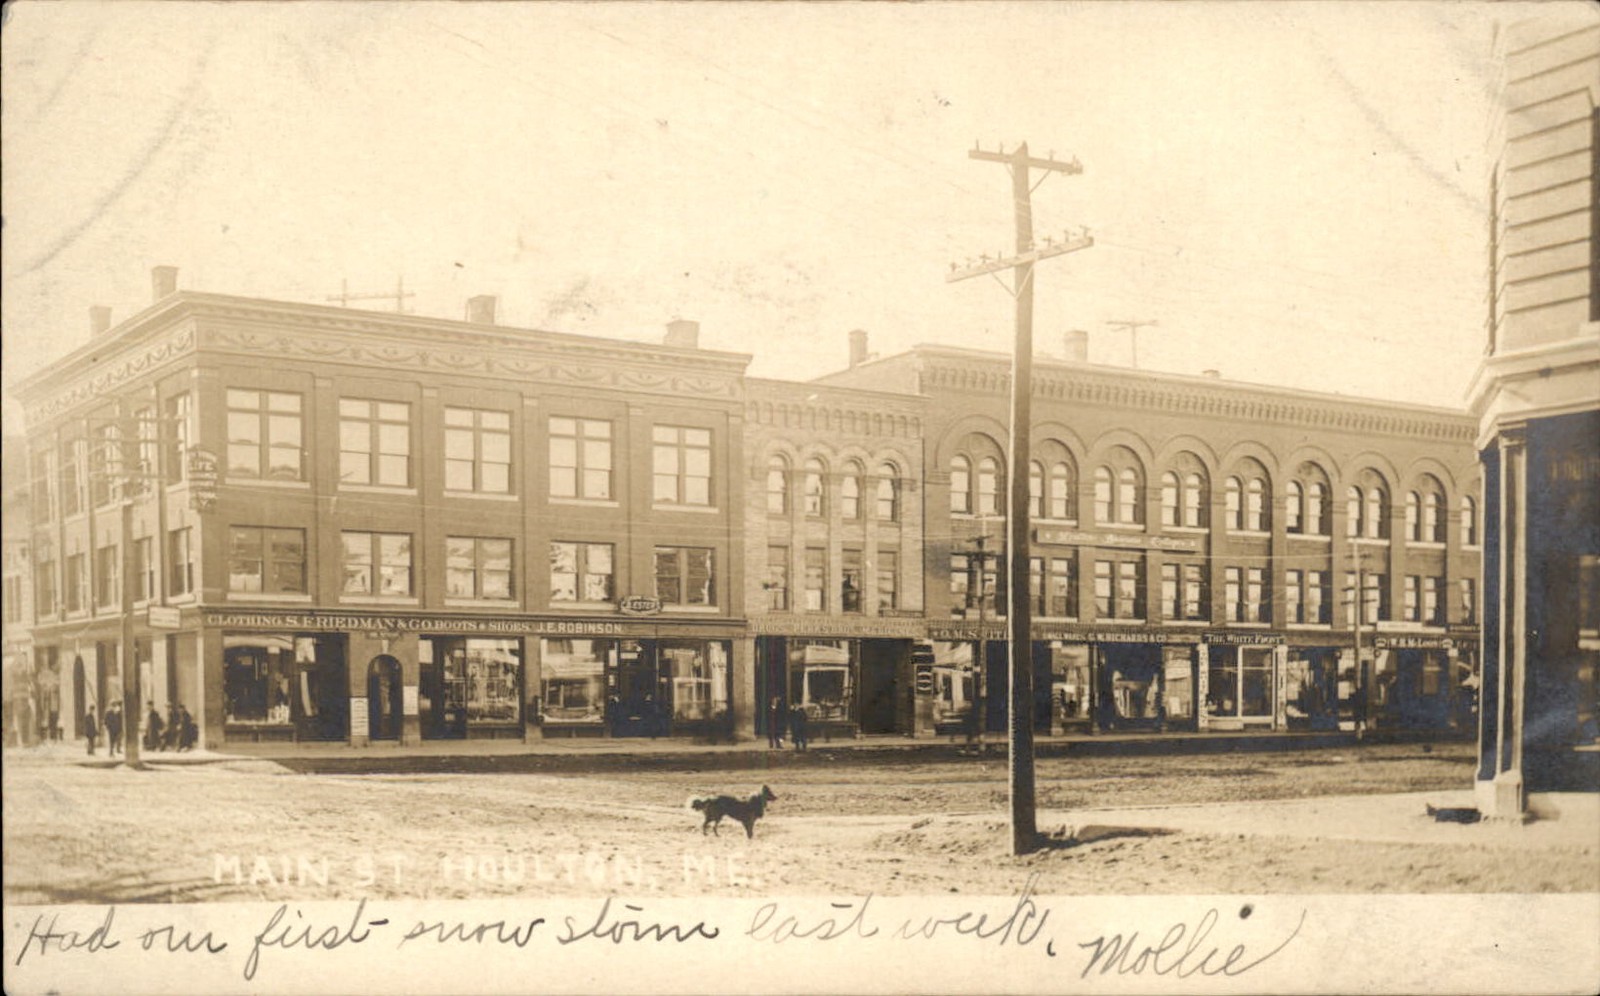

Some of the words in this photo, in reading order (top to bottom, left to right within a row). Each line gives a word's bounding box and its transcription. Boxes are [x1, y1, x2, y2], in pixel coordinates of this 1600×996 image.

[206, 614, 282, 626] CLOTHING
[303, 615, 397, 629] FRIEDMAN
[397, 618, 408, 630] &
[434, 619, 477, 631] BOOTS
[488, 621, 530, 632] SHOES
[558, 622, 622, 634] ROBINSON
[15, 904, 121, 967] Had
[245, 898, 388, 980] first
[403, 916, 546, 952] snow
[744, 893, 878, 944] last
[1078, 904, 1306, 980] Mollie
